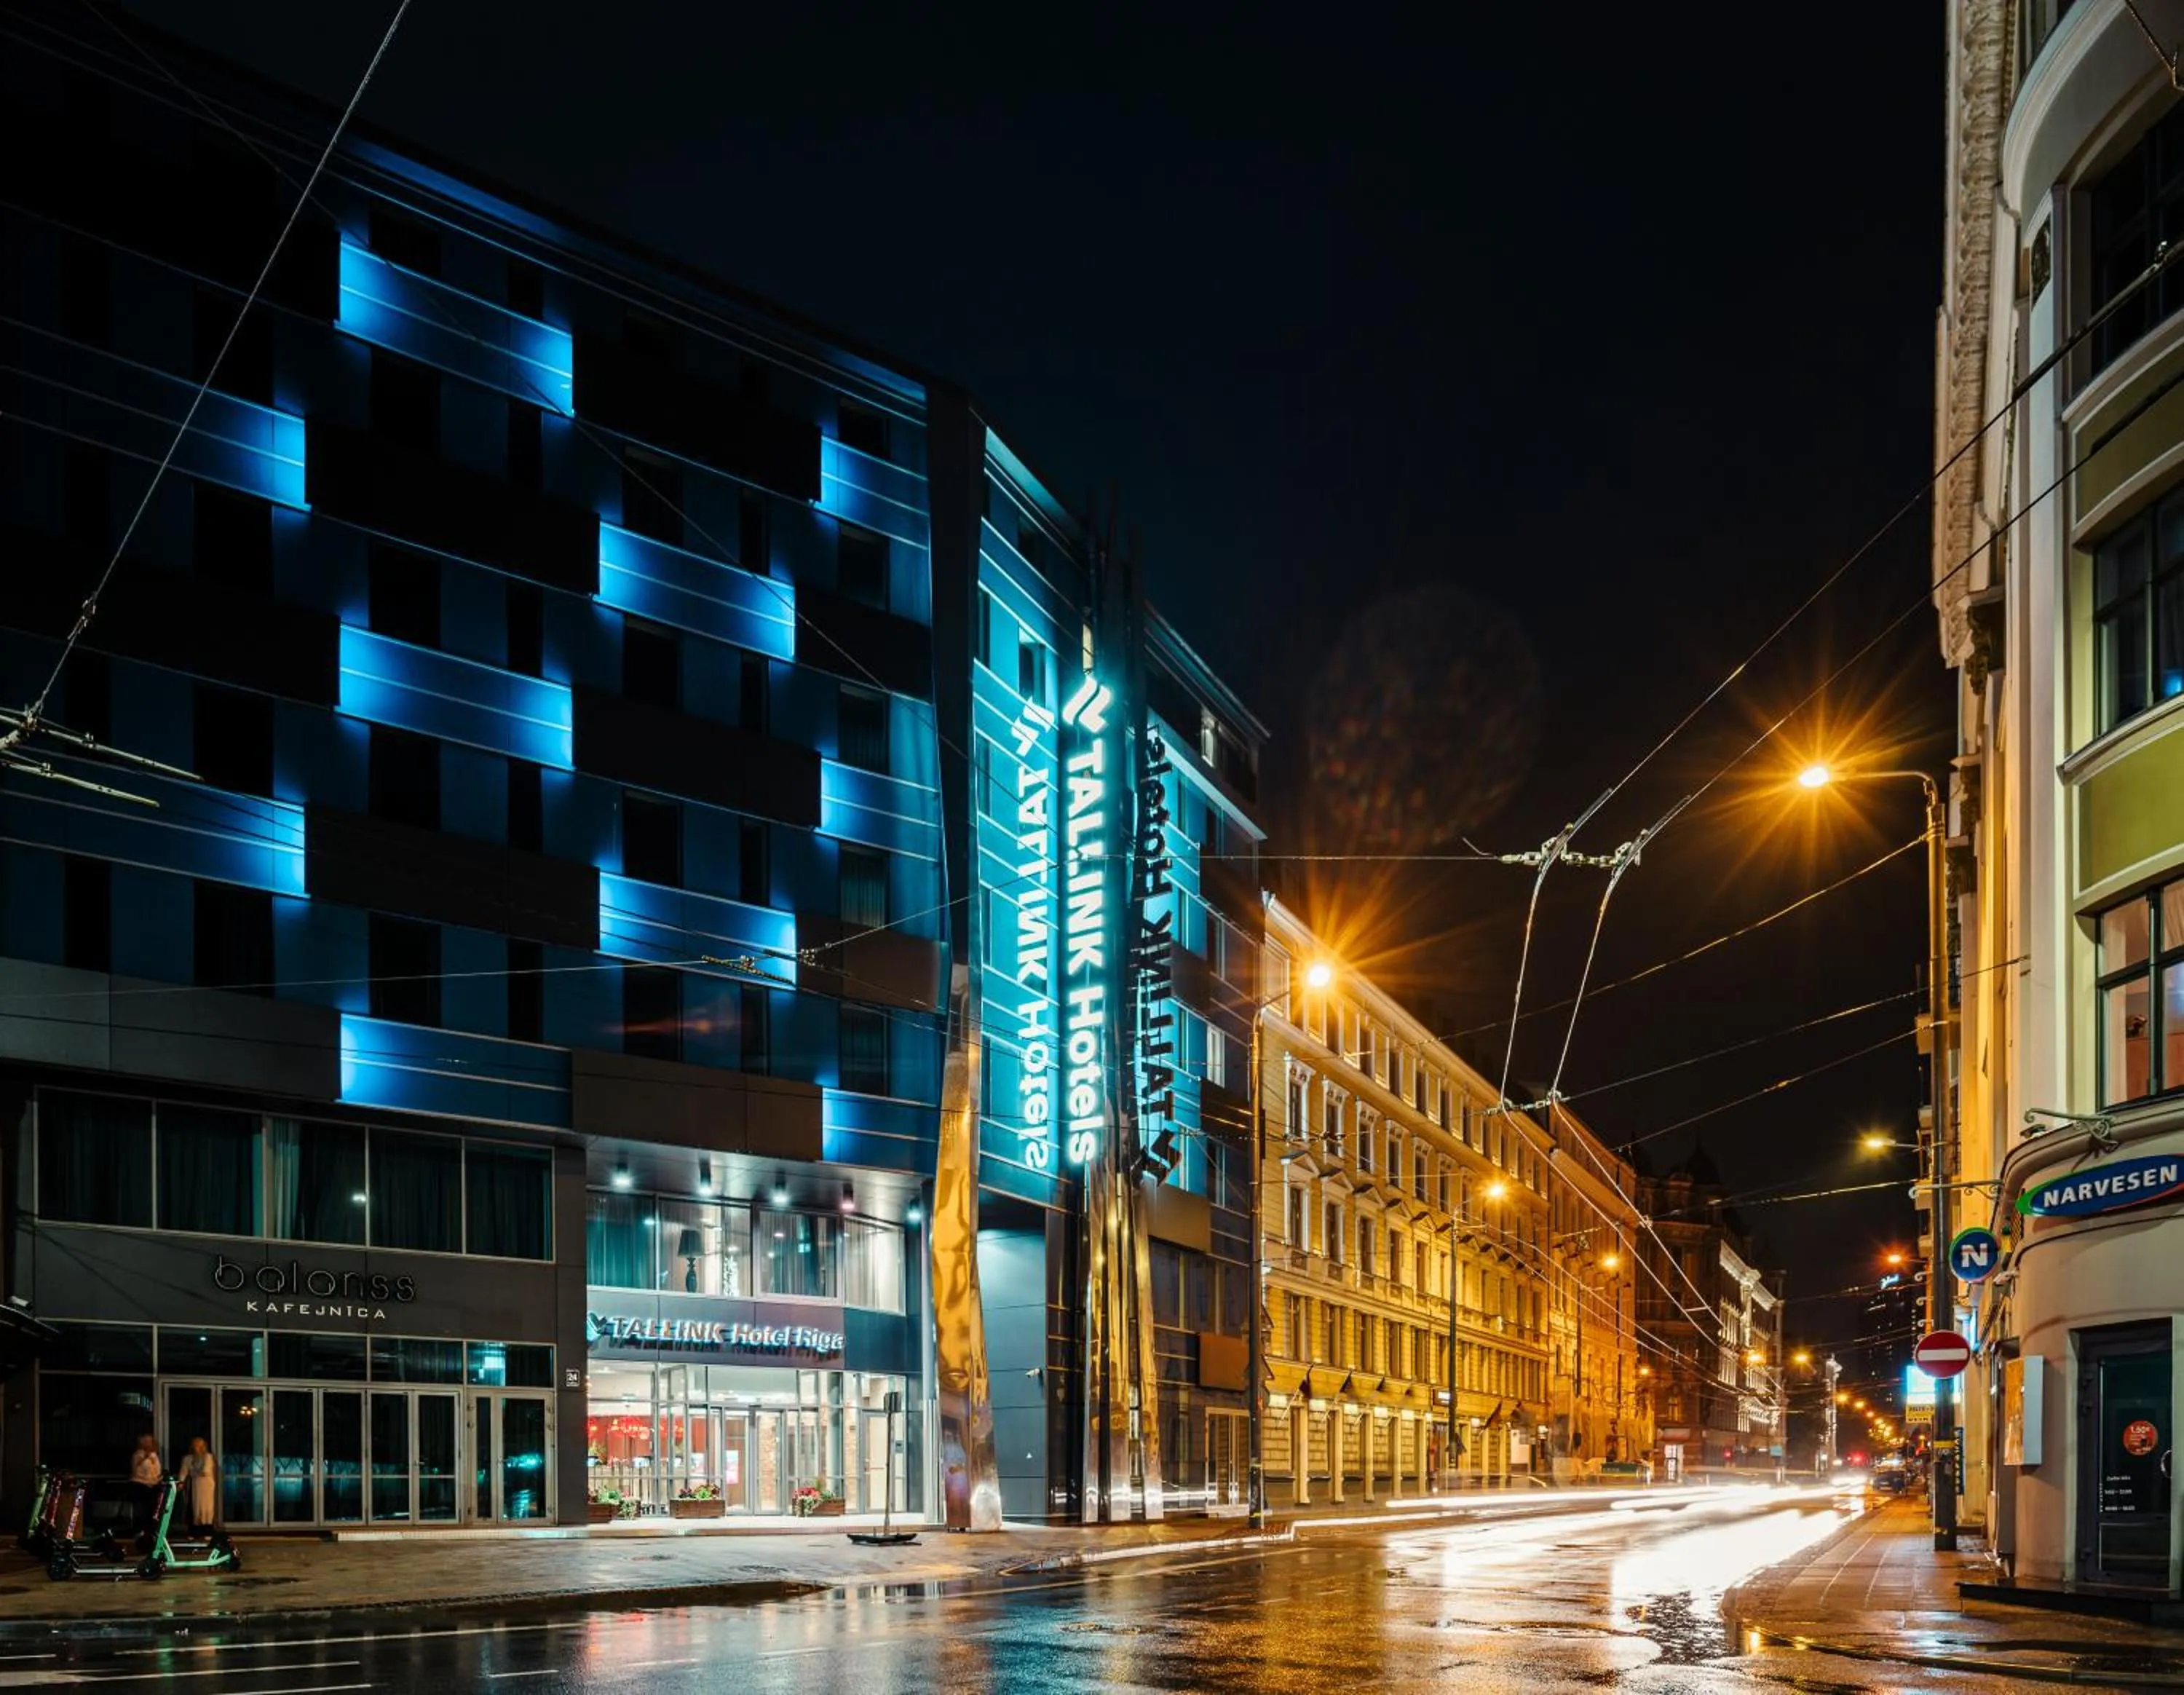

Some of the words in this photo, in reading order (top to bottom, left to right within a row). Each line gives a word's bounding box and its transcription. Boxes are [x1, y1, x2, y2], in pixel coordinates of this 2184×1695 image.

[1067, 738, 1104, 975] TALLINK
[1068, 984, 1105, 1163] Hotels
[2043, 1164, 2178, 1207] NARVESEN
[1961, 1242, 1988, 1268] N
[247, 1300, 386, 1319] KAFEJNĪCA
[611, 1315, 724, 1343] TALLINK
[730, 1322, 791, 1346] Hotel
[795, 1325, 844, 1353] Riga
[567, 1372, 577, 1381] 24
